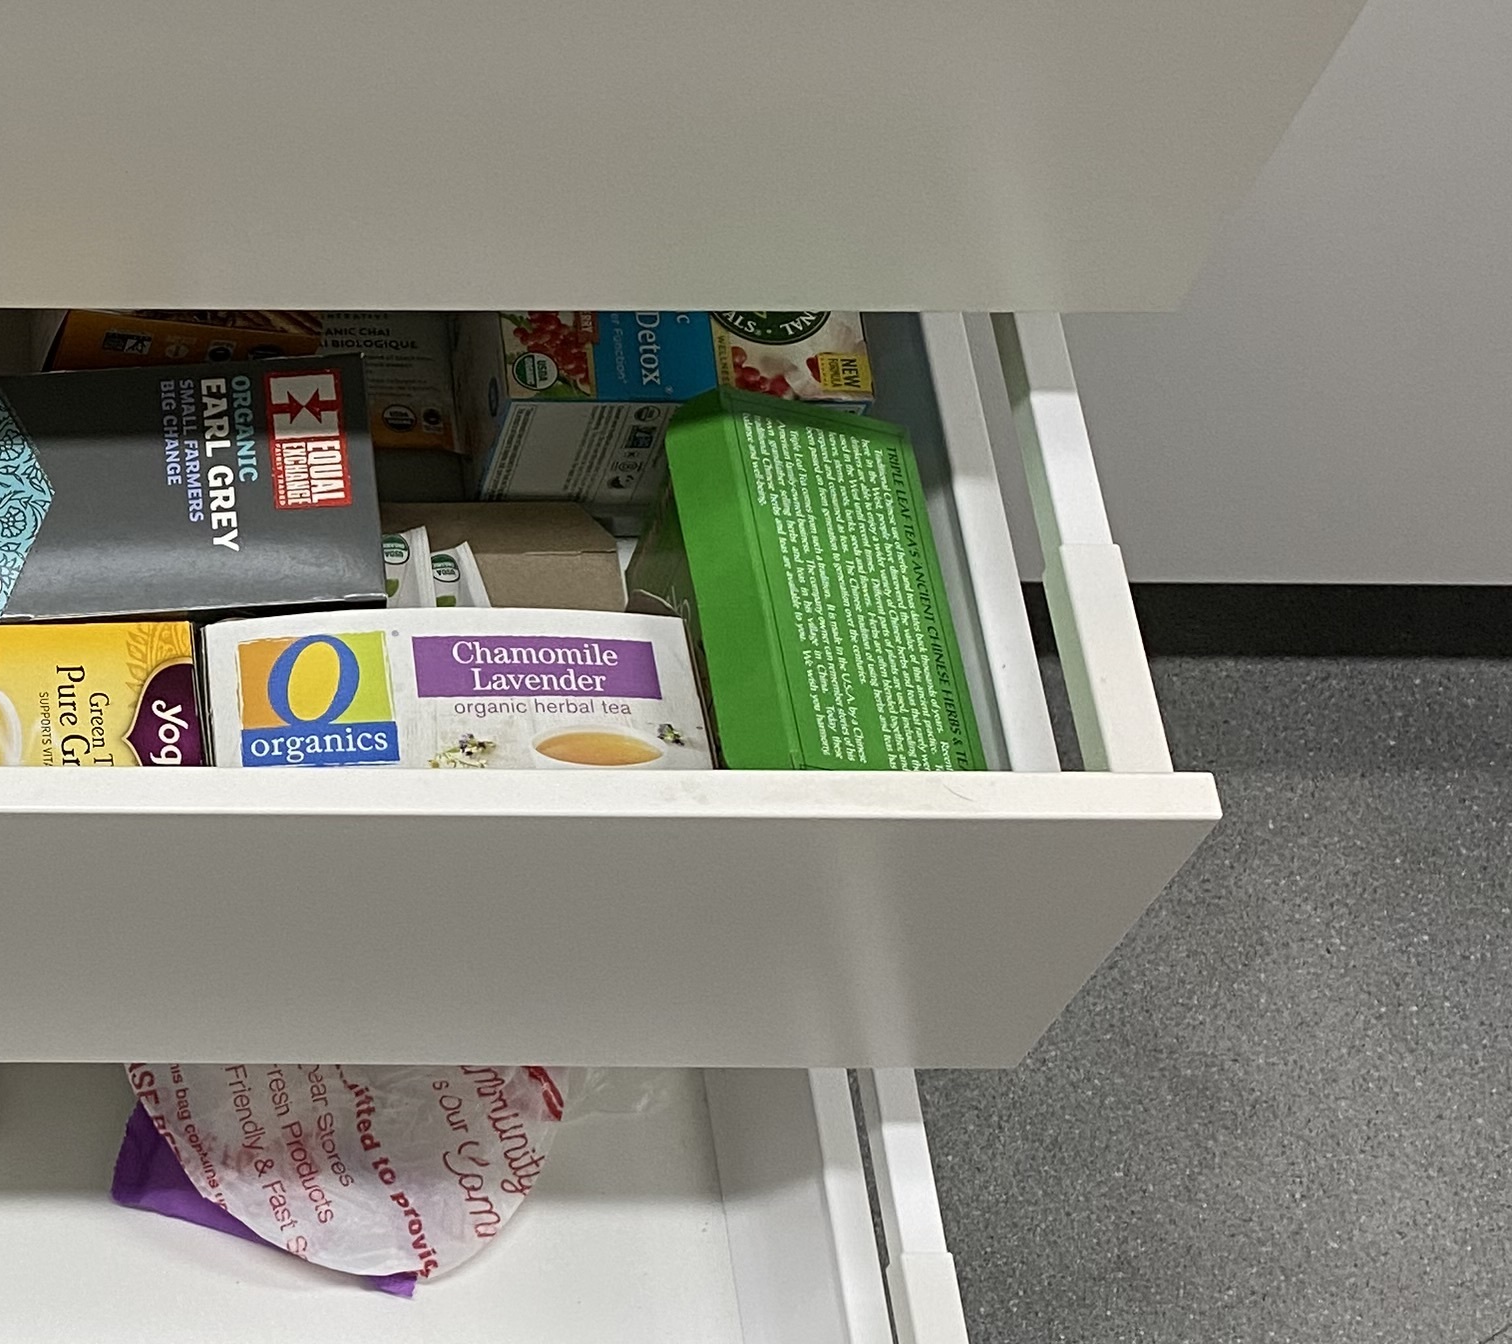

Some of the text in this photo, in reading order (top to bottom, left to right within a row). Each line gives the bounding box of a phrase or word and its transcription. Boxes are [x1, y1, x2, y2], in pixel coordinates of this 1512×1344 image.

[537, 359, 548, 382] USDA
[635, 311, 661, 386] Detox
[840, 358, 860, 388] NEW
[160, 380, 182, 486] BIG CHANGE
[180, 380, 204, 523] SMALL FARMERS
[232, 375, 258, 482] ORGANIC
[201, 378, 239, 552] EARL GREY
[282, 442, 311, 505] EXCHANGE
[307, 440, 345, 504] EQUAL
[887, 448, 903, 485] TRIPLE
[896, 489, 911, 520] LEAF
[912, 561, 934, 622] ANCIENT
[927, 626, 949, 684] CHINESE
[941, 689, 960, 734] HERBS
[451, 640, 619, 667] Chamomile
[471, 667, 607, 692] Lavender
[39, 692, 51, 745] SUPPORTS
[56, 665, 85, 726] Pure
[89, 692, 110, 748] Green
[454, 697, 631, 717] organic herbal tea
[250, 727, 388, 763] organics
[176, 1087, 192, 1122] bag
[225, 1064, 266, 1152] Friendly
[254, 1158, 274, 1178] &
[281, 1120, 334, 1225] Products
[317, 1111, 355, 1188] Stores
[371, 1156, 397, 1186] to
[262, 1180, 298, 1231] Fast
